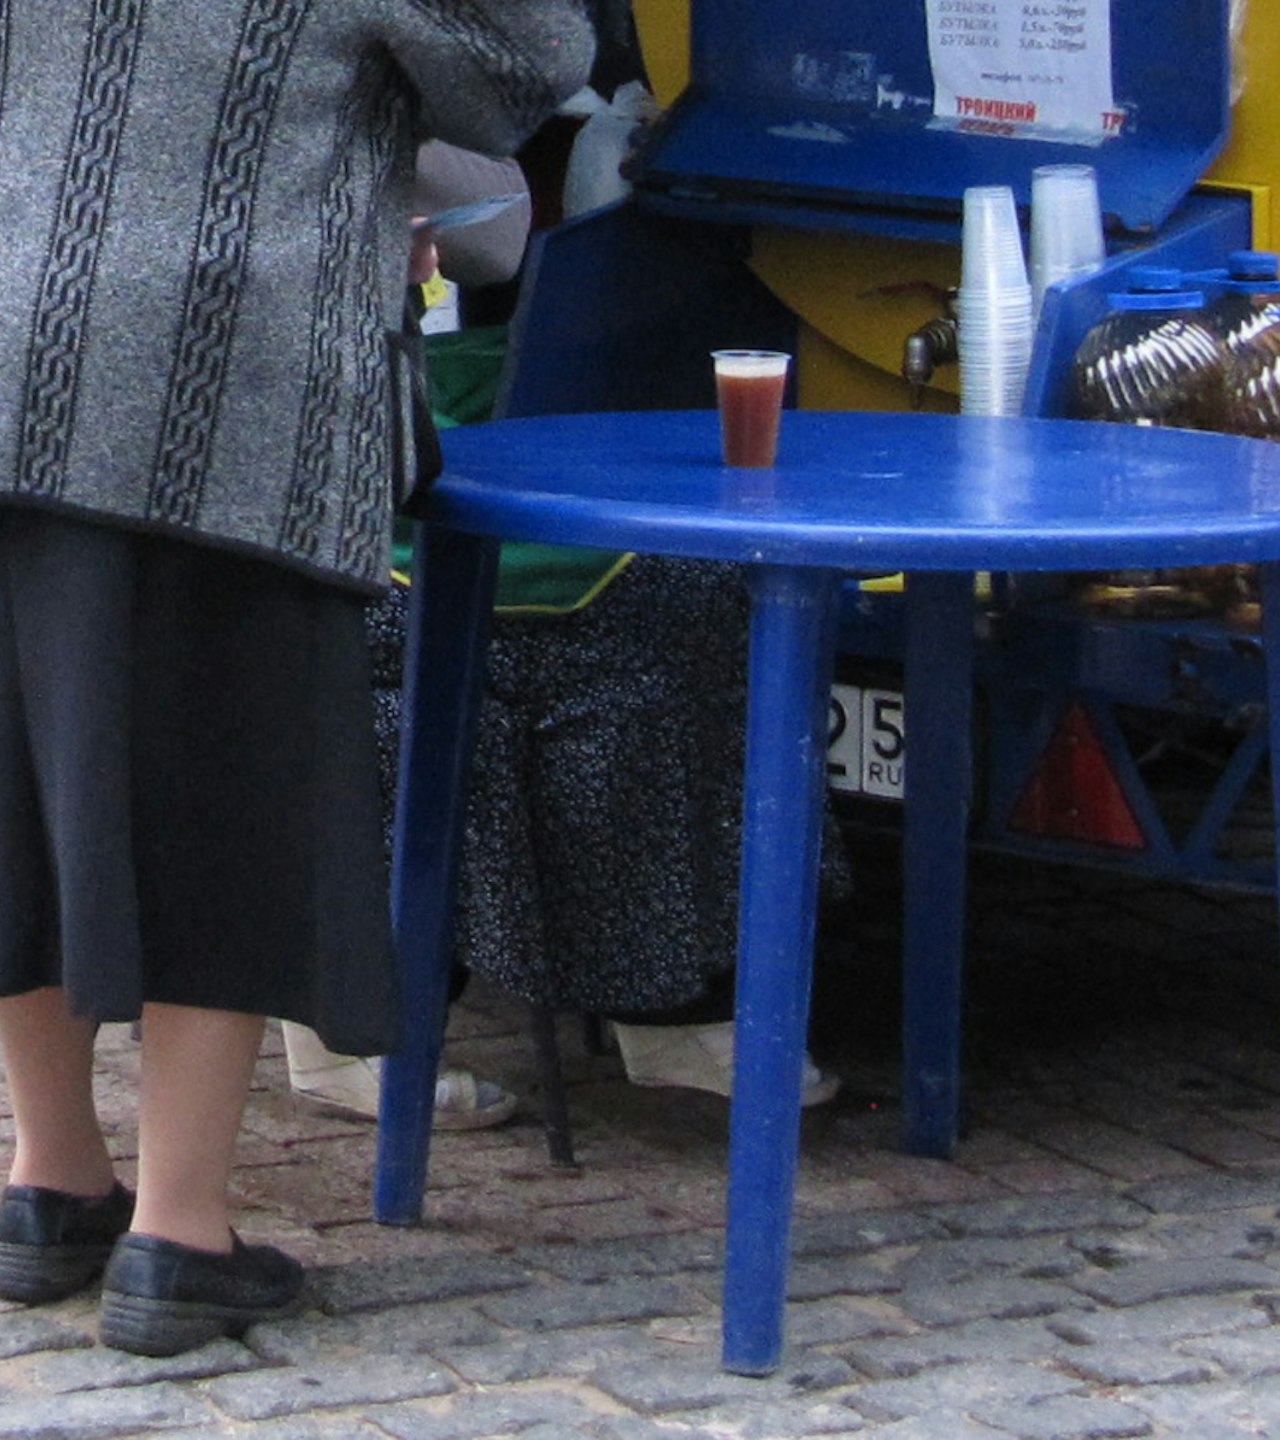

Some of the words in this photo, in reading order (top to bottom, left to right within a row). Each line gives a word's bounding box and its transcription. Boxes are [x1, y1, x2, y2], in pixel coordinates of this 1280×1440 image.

[955, 95, 1038, 123] ТРОИЦКИЙ
[871, 697, 904, 762] 5
[869, 761, 903, 786] RU
